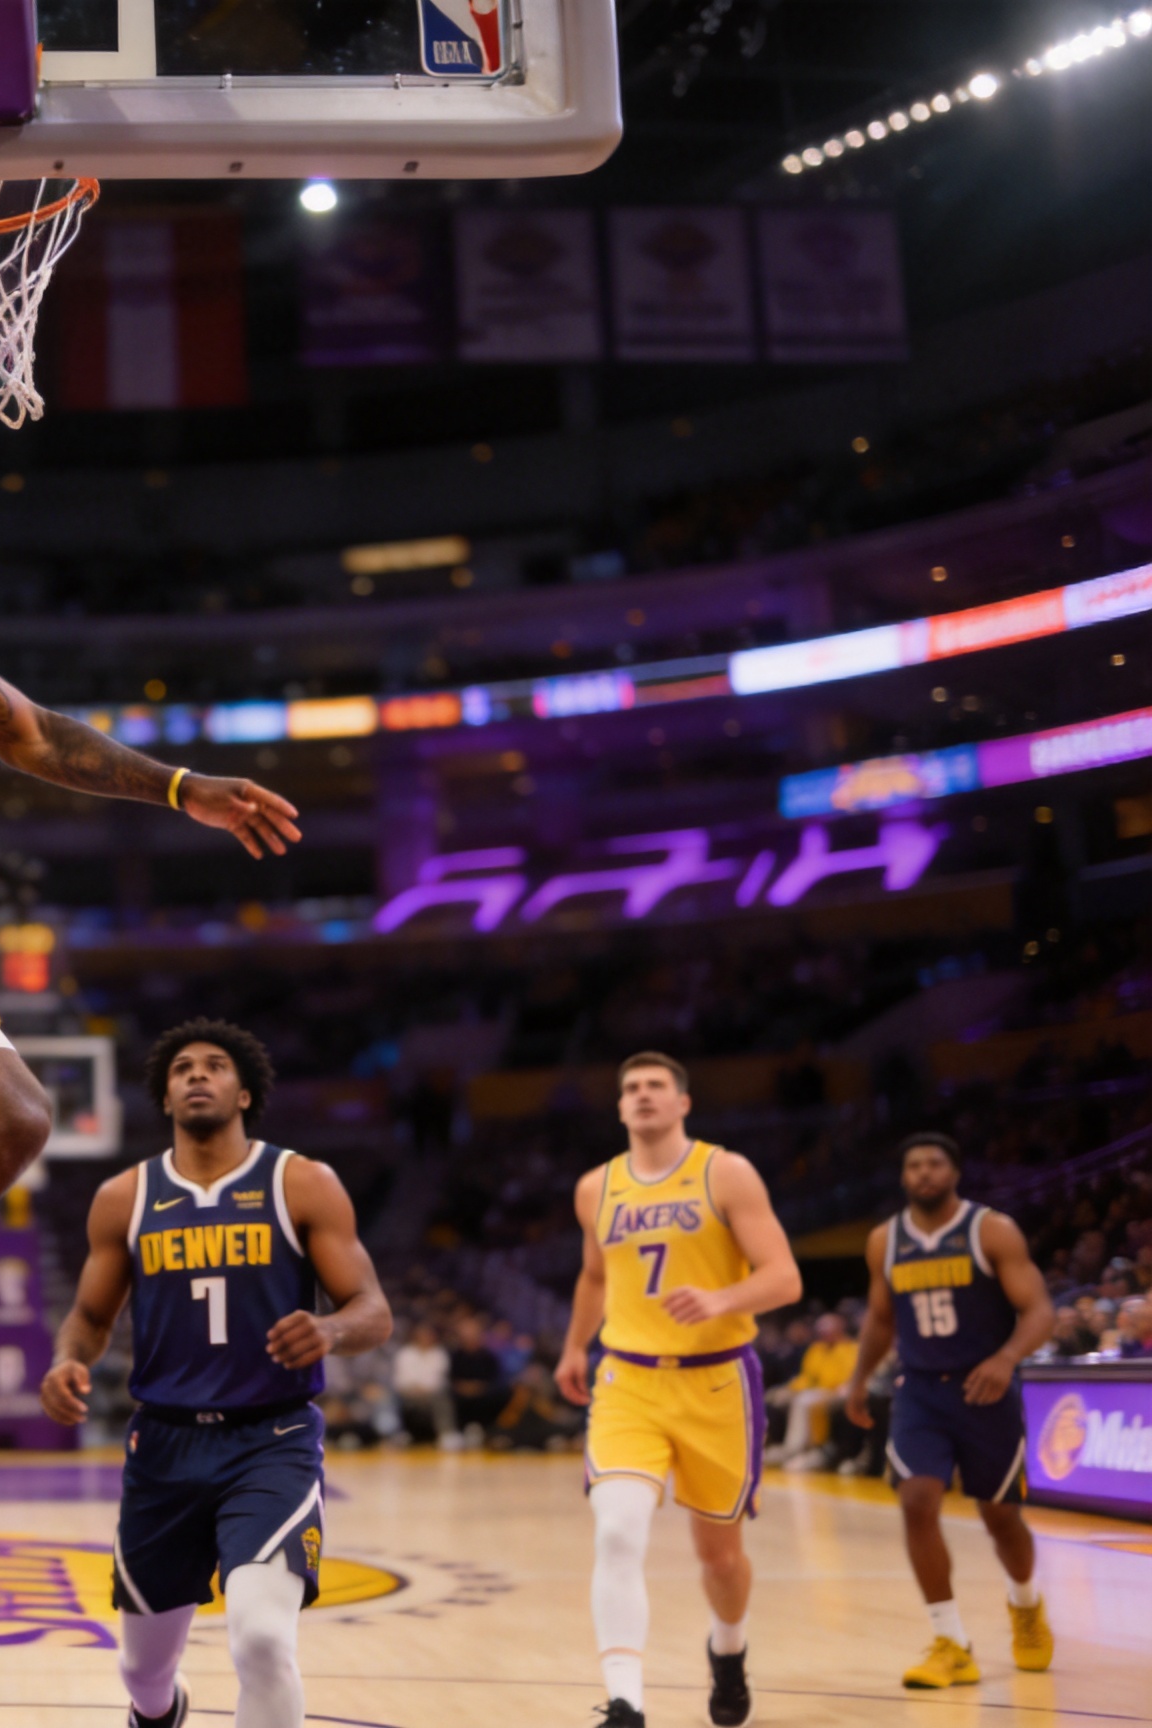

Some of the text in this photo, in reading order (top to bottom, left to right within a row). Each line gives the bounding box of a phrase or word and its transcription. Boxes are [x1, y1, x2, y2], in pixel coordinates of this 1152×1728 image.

[603, 1199, 702, 1245] LAKERS
[638, 1242, 668, 1297] 7
[190, 1275, 229, 1345] 7
[910, 1287, 959, 1338] 15
